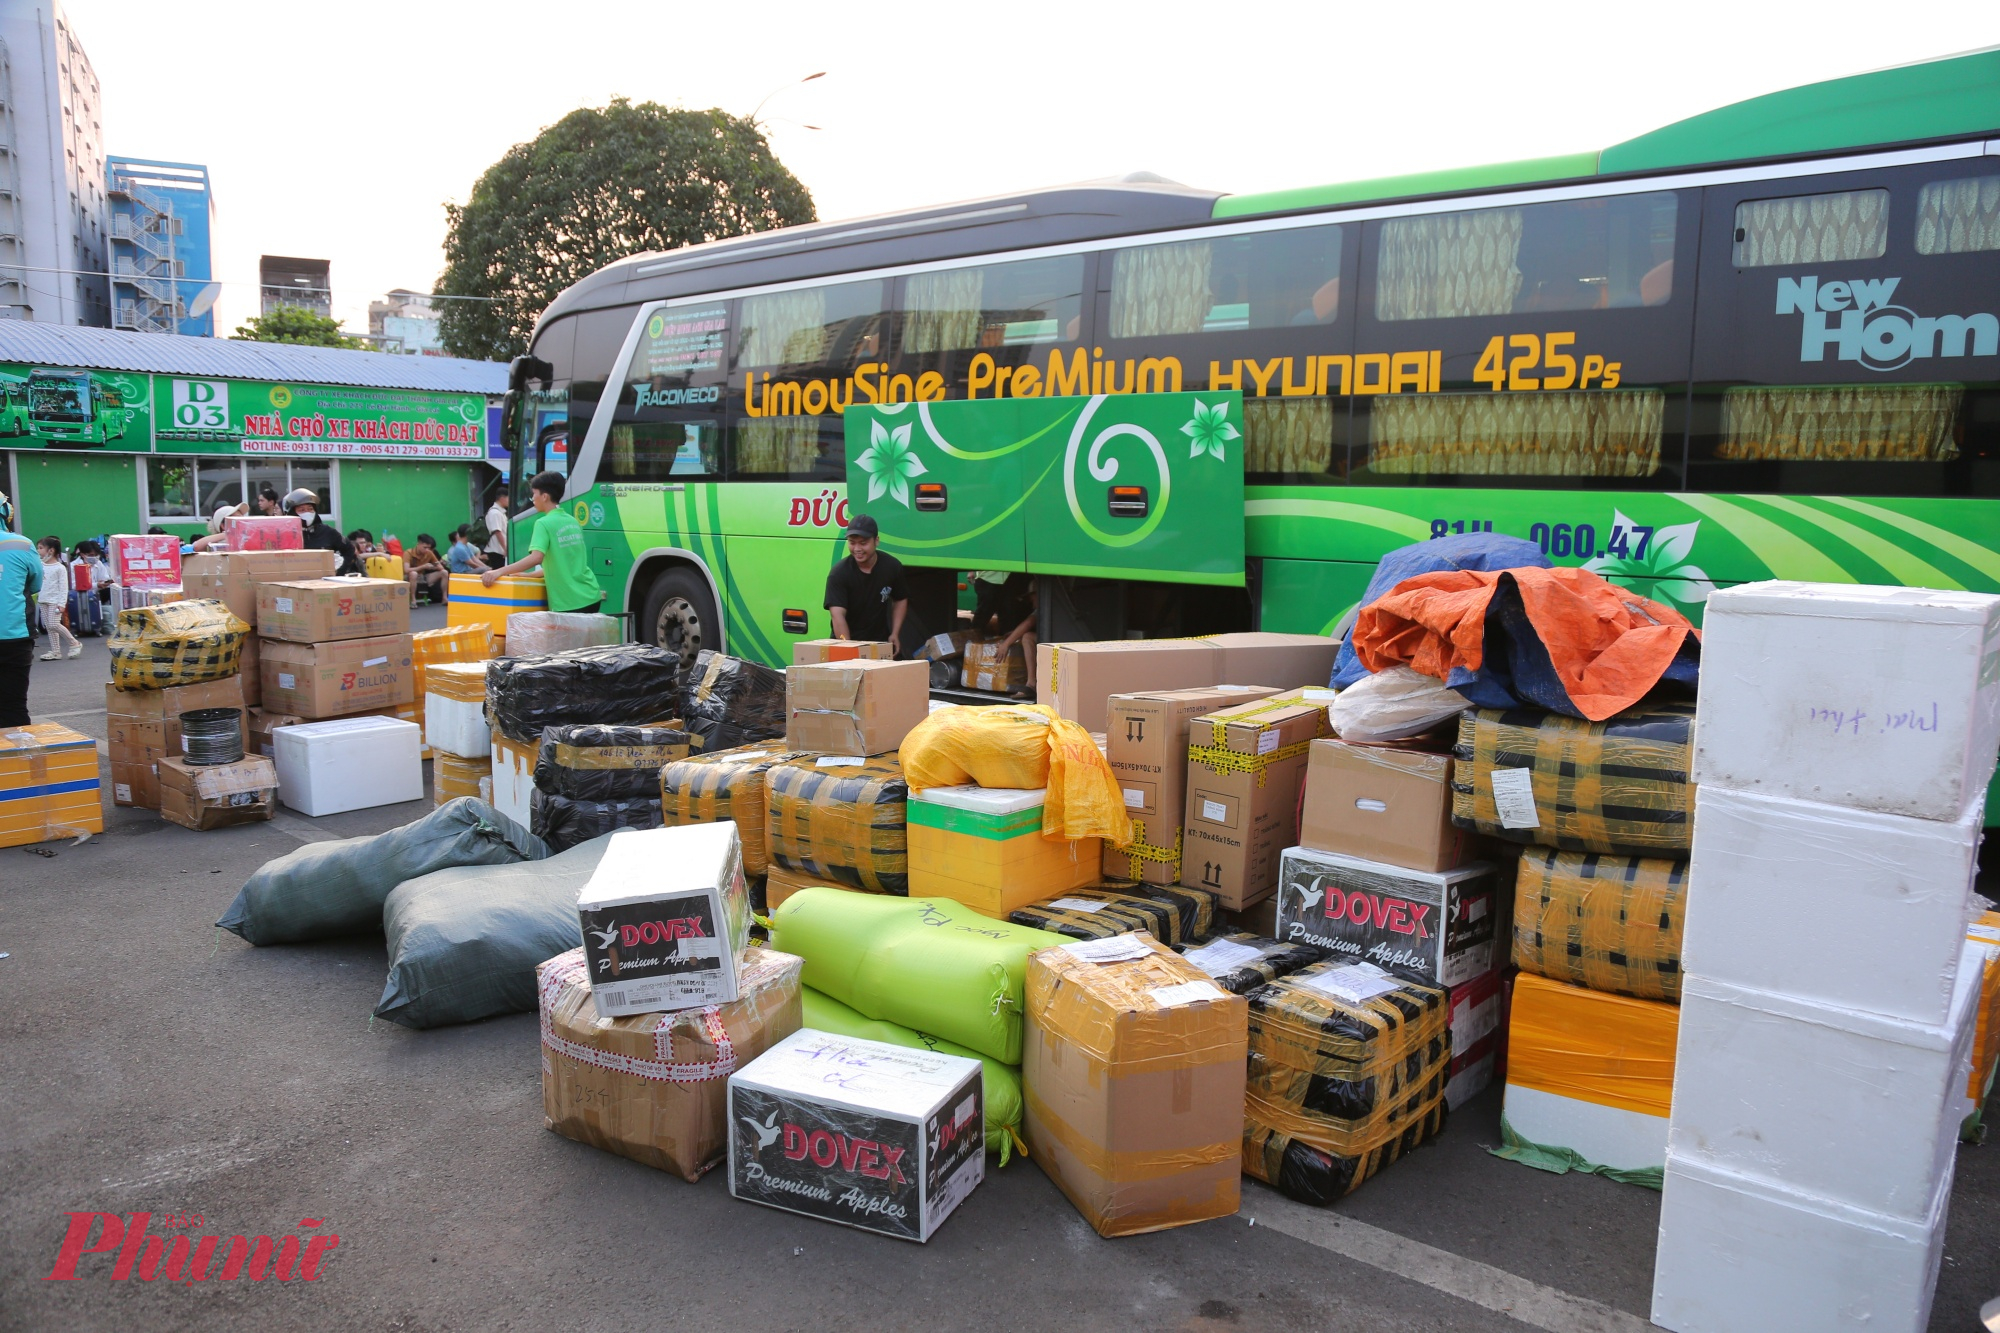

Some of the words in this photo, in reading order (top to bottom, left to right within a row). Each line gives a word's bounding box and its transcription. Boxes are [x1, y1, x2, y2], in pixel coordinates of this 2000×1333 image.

[1775, 275, 1902, 315] New
[745, 362, 946, 418] LimouSine
[968, 346, 1183, 400] PreMium
[1208, 349, 1442, 397] HYUNDAI
[1473, 331, 1577, 392] 425
[1579, 354, 1622, 389] Ps
[187, 381, 215, 403] D
[319, 389, 329, 397] TY
[631, 383, 719, 416] TRACOMECO
[176, 404, 226, 427] 03
[244, 410, 284, 437] NHÀ
[288, 412, 325, 438] CHỜ
[327, 418, 351, 439] XE
[354, 415, 411, 440] KHÁCH
[413, 417, 445, 442] ĐỨC
[448, 423, 479, 447] ĐẠT
[243, 441, 290, 452] HOTLINE:
[291, 442, 315, 453] 0931
[317, 443, 334, 454] 187
[336, 443, 353, 454] 187
[360, 444, 382, 454] 0905
[384, 445, 400, 455] 421
[402, 445, 418, 455] 279
[424, 446, 445, 456] 0901
[446, 447, 462, 456] 933
[463, 447, 478, 457] 279
[1529, 522, 1655, 561] 060.47
[354, 602, 393, 615] BILLION
[358, 673, 397, 688] BILLION
[1111, 762, 1151, 774] 70x45x15cm
[1188, 828, 1198, 838] KT:
[1199, 829, 1241, 848] 70x45x15cm
[1324, 885, 1431, 939] DOVEX
[620, 916, 707, 948] DOVEX
[1288, 921, 1363, 953] Premium
[1366, 941, 1428, 970] Apples
[601, 1055, 622, 1064] FRAGILE
[676, 1067, 703, 1075] FRAGILE
[783, 1122, 907, 1184] DOVEX
[745, 1162, 833, 1201] Premium
[836, 1187, 908, 1219] Apples
